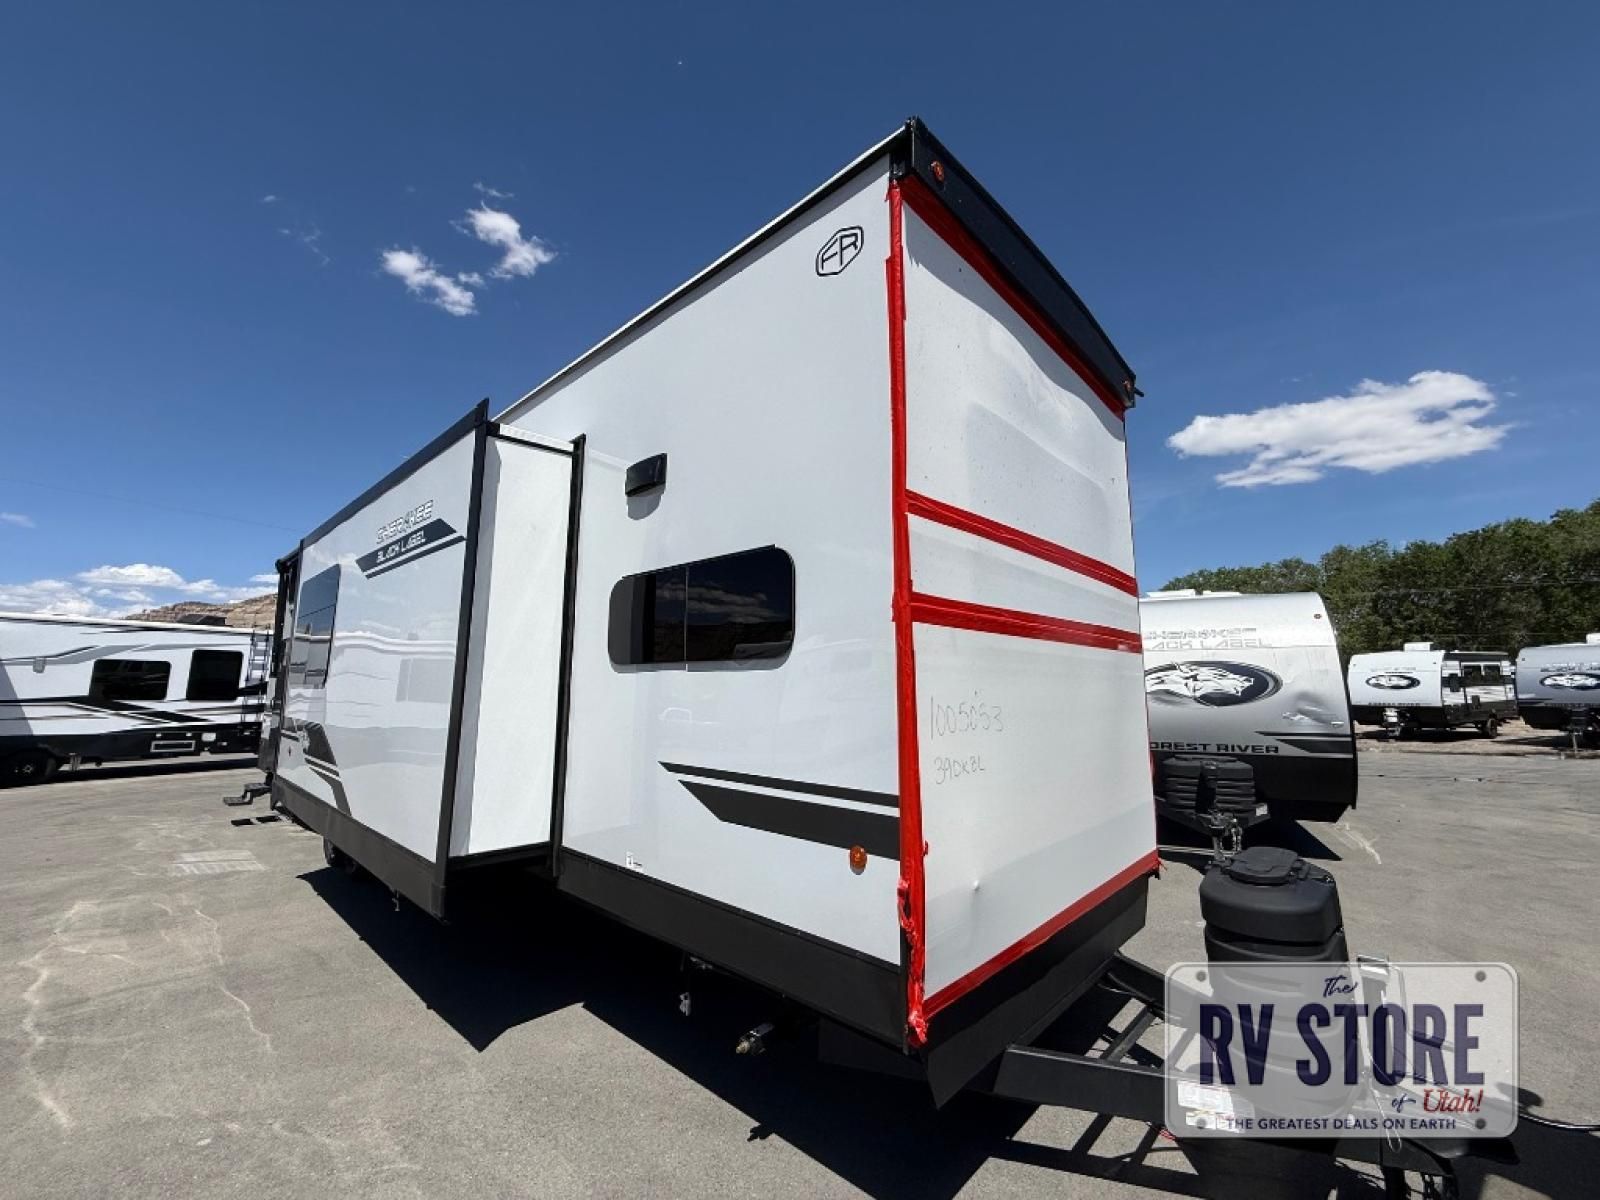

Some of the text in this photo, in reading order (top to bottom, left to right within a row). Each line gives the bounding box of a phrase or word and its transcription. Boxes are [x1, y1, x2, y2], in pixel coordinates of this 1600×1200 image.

[820, 231, 859, 271] FR
[1151, 640, 1193, 650] ACK
[1149, 741, 1279, 754] OREST RIVER
